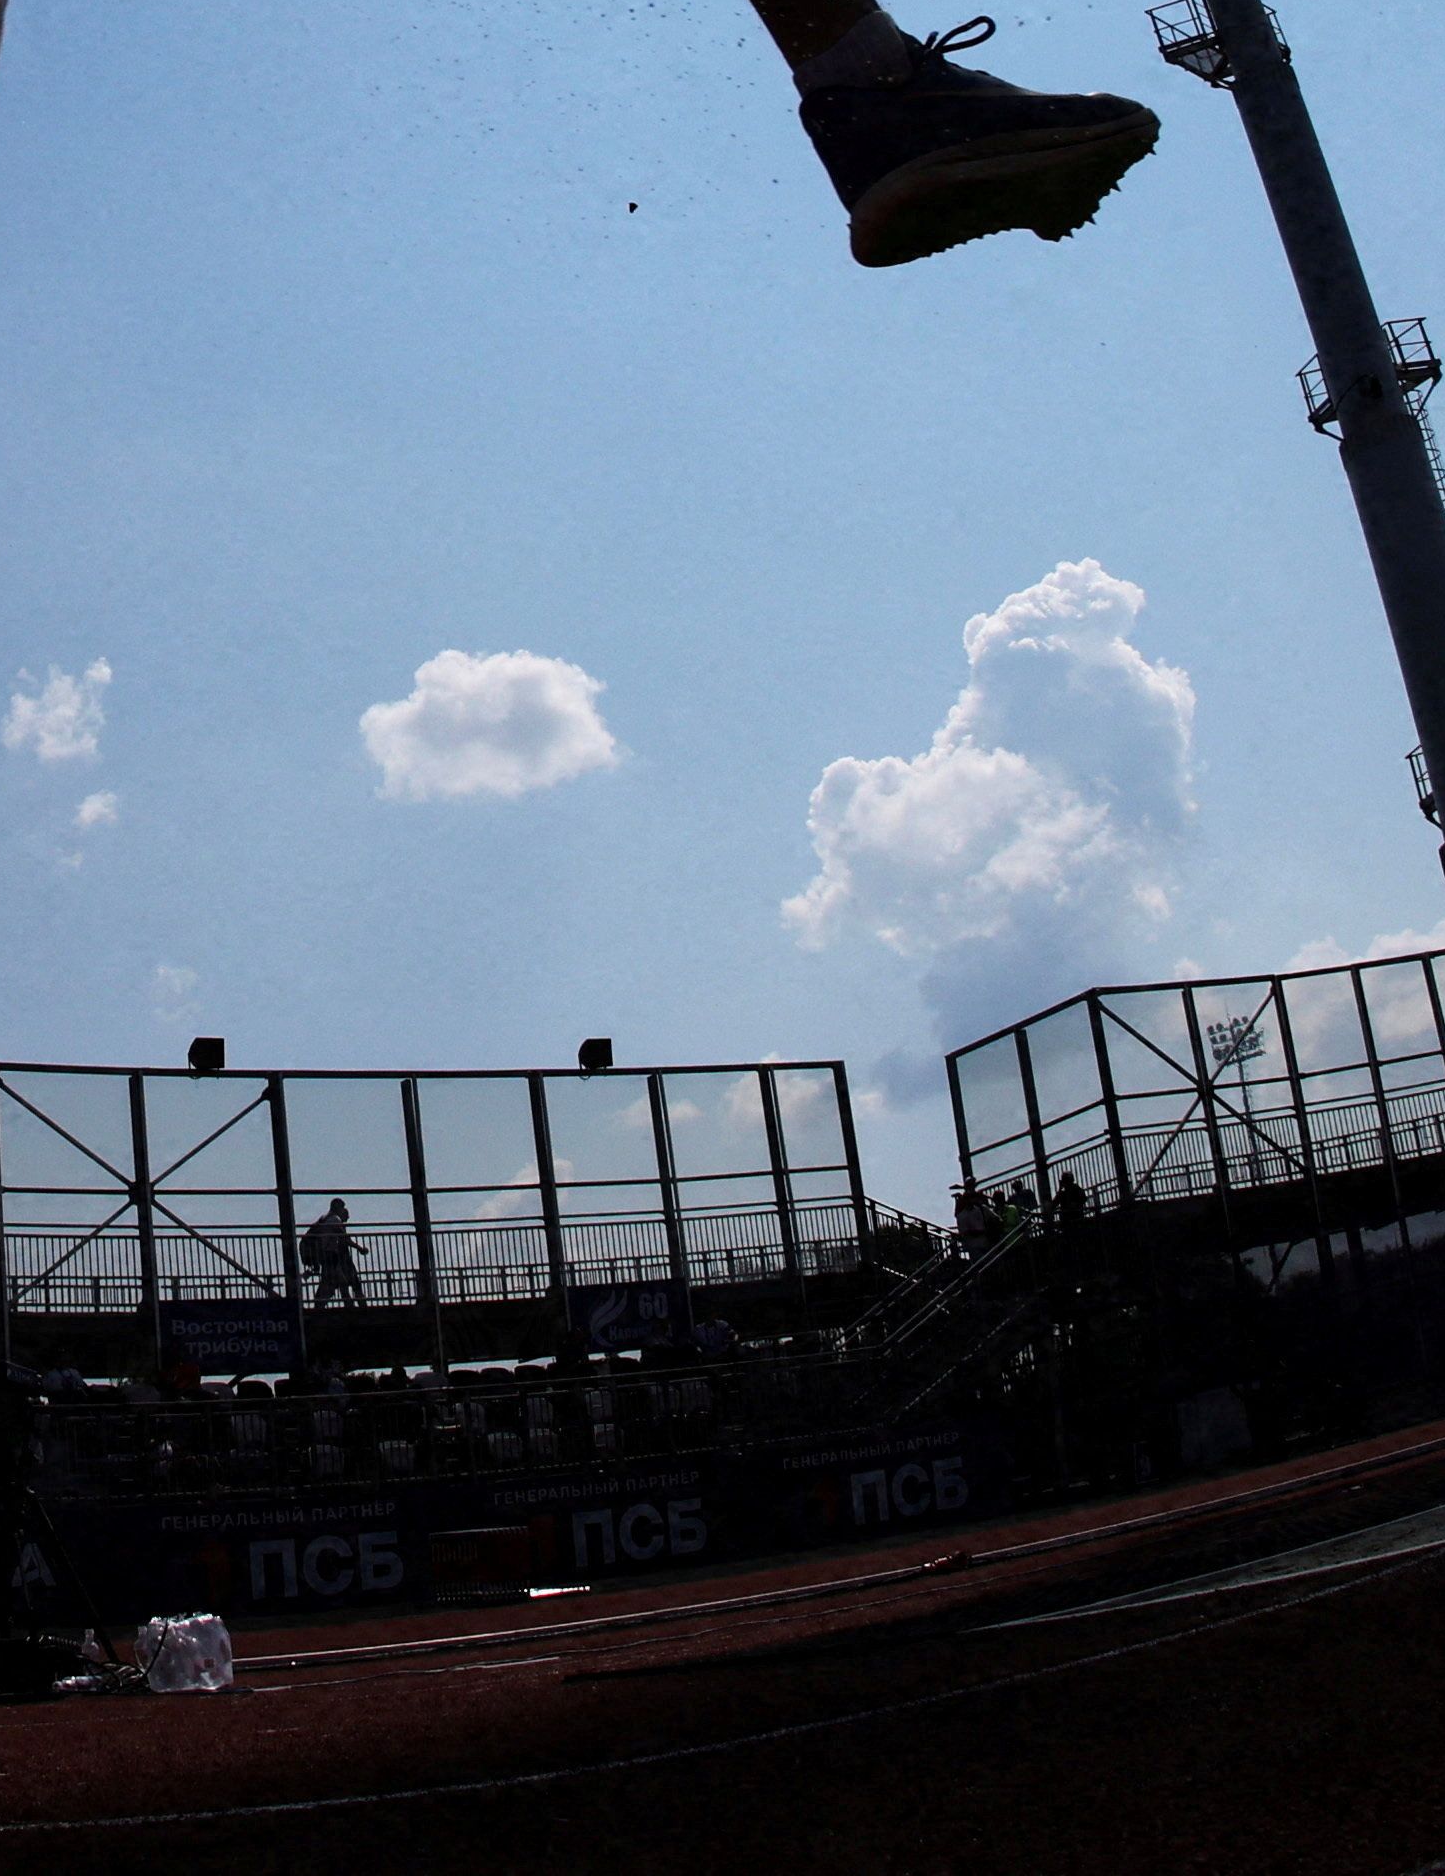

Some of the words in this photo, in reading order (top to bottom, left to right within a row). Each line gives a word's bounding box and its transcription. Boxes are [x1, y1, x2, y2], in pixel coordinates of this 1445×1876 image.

[638, 1292, 669, 1321] 60
[171, 1319, 289, 1336] Восточная
[184, 1336, 279, 1358] трибуна
[782, 1444, 891, 1471] ГЕНЕРАЛЬНЫЙ
[493, 1481, 618, 1507] ГЕНЕРАЛЬНЫЙ
[849, 1455, 970, 1526] ПСБ
[161, 1506, 304, 1531] ГЕНЕРАЛЬНЫЙ
[571, 1497, 708, 1568] ПСБ
[249, 1530, 404, 1601] ПСБ
